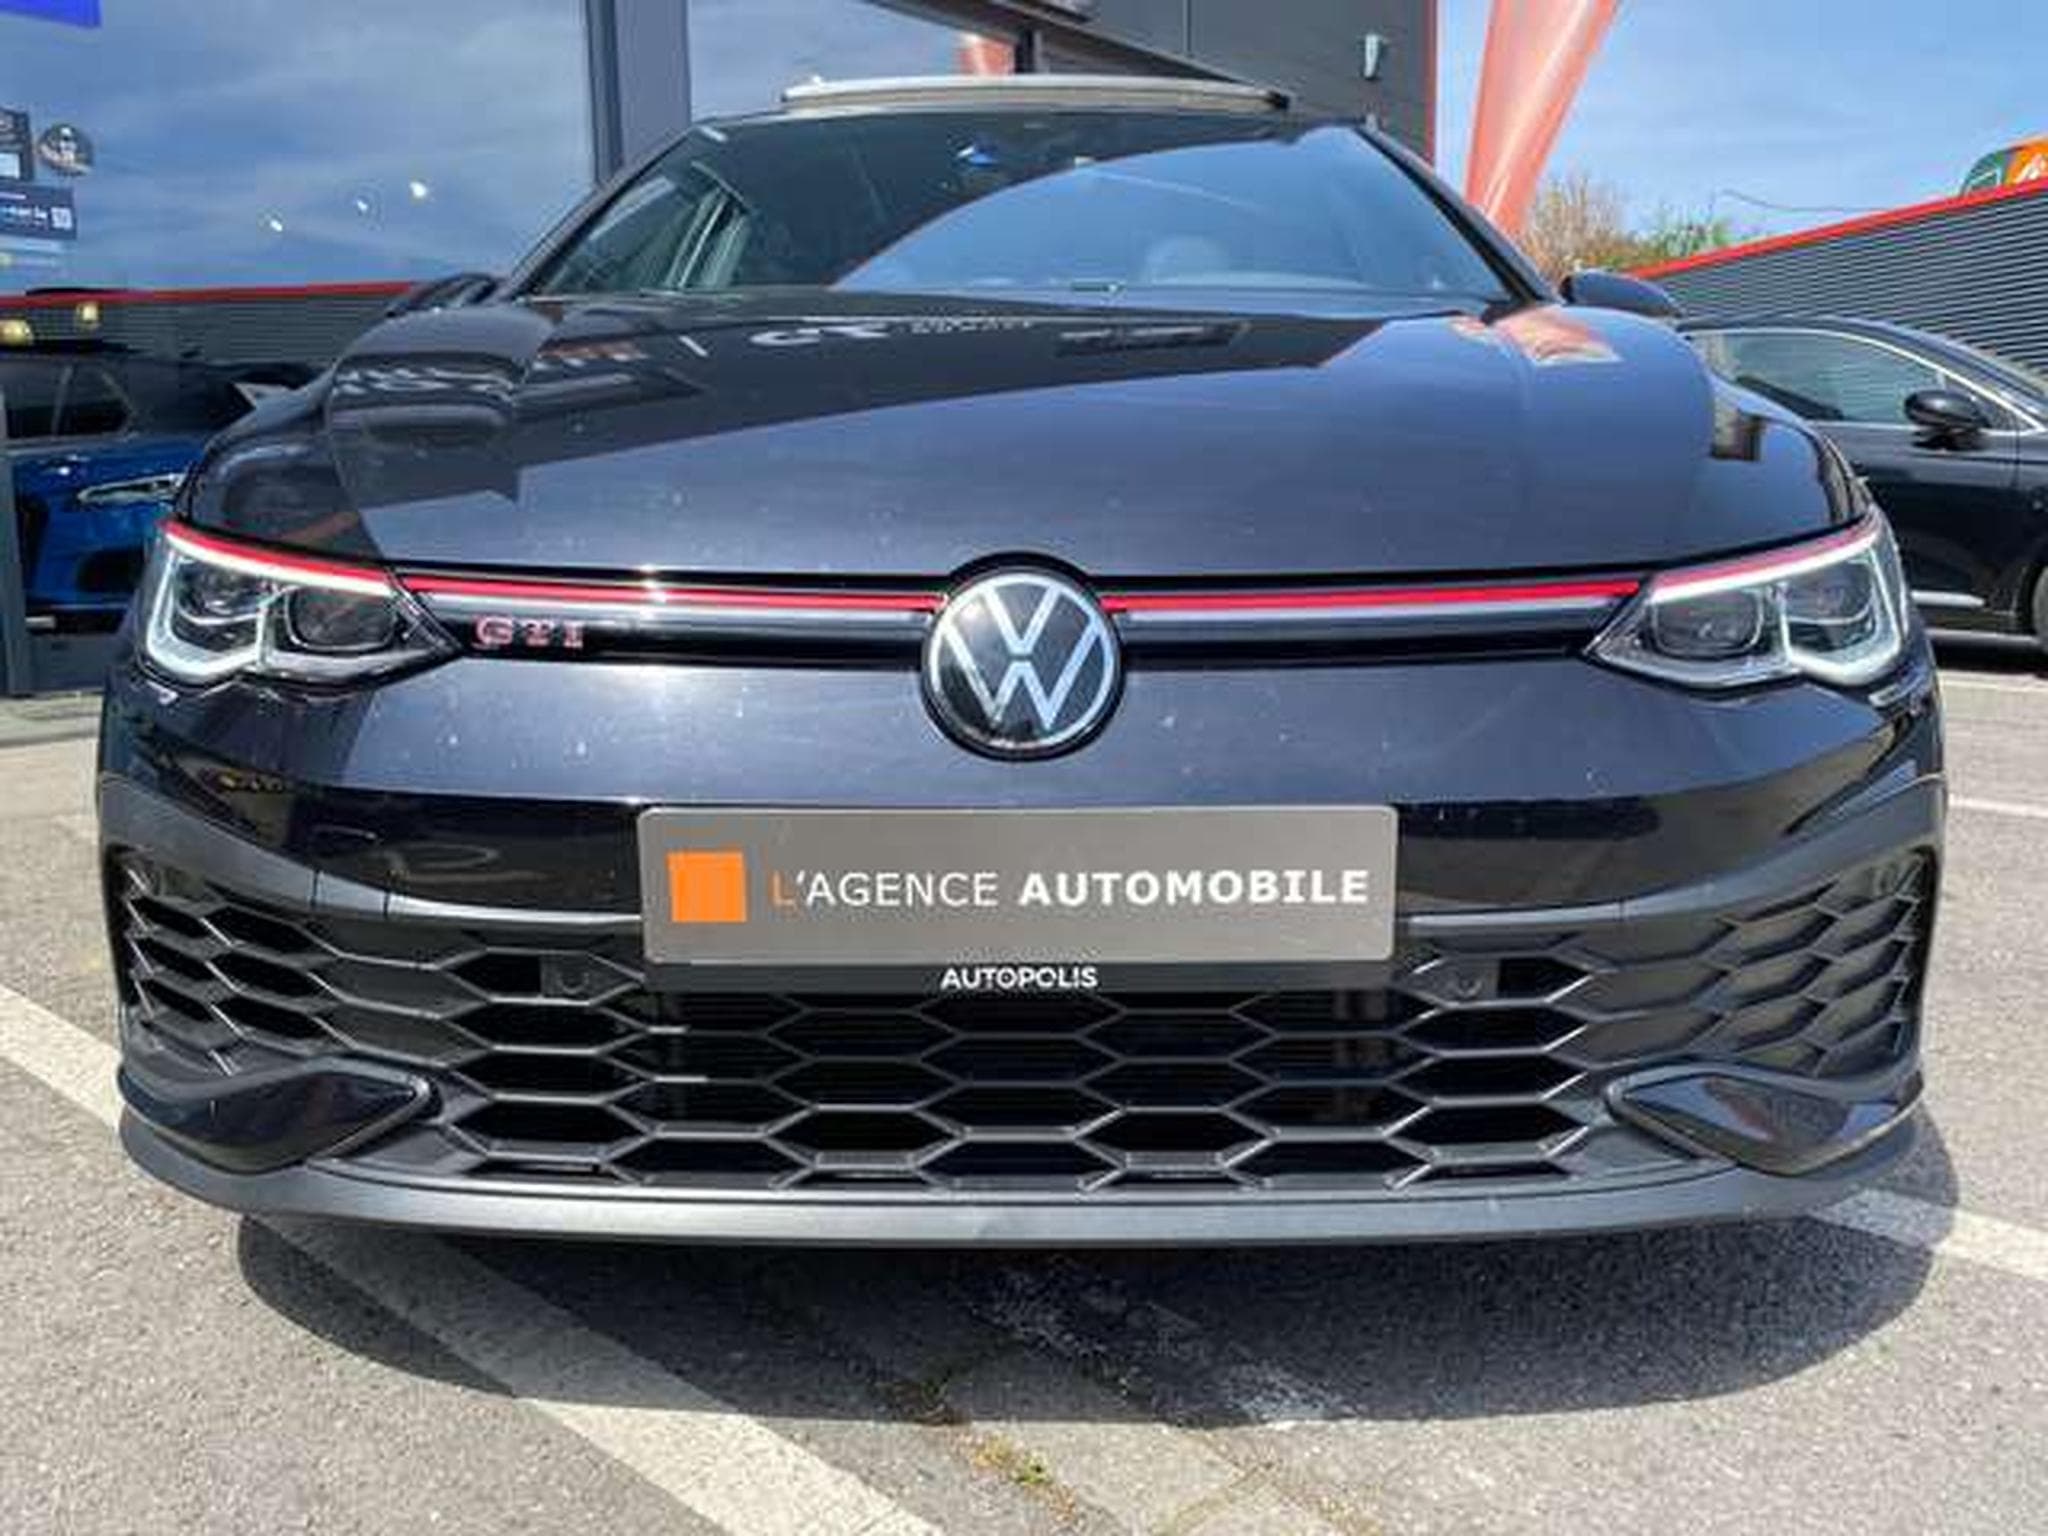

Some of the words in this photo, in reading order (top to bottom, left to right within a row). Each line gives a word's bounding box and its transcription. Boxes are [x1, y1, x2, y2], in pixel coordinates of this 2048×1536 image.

[473, 615, 583, 649] GTI
[769, 869, 999, 907] L'AGENCE
[1018, 869, 1369, 906] AUTOMOBILE
[940, 965, 1099, 990] AUTOPOLIS
